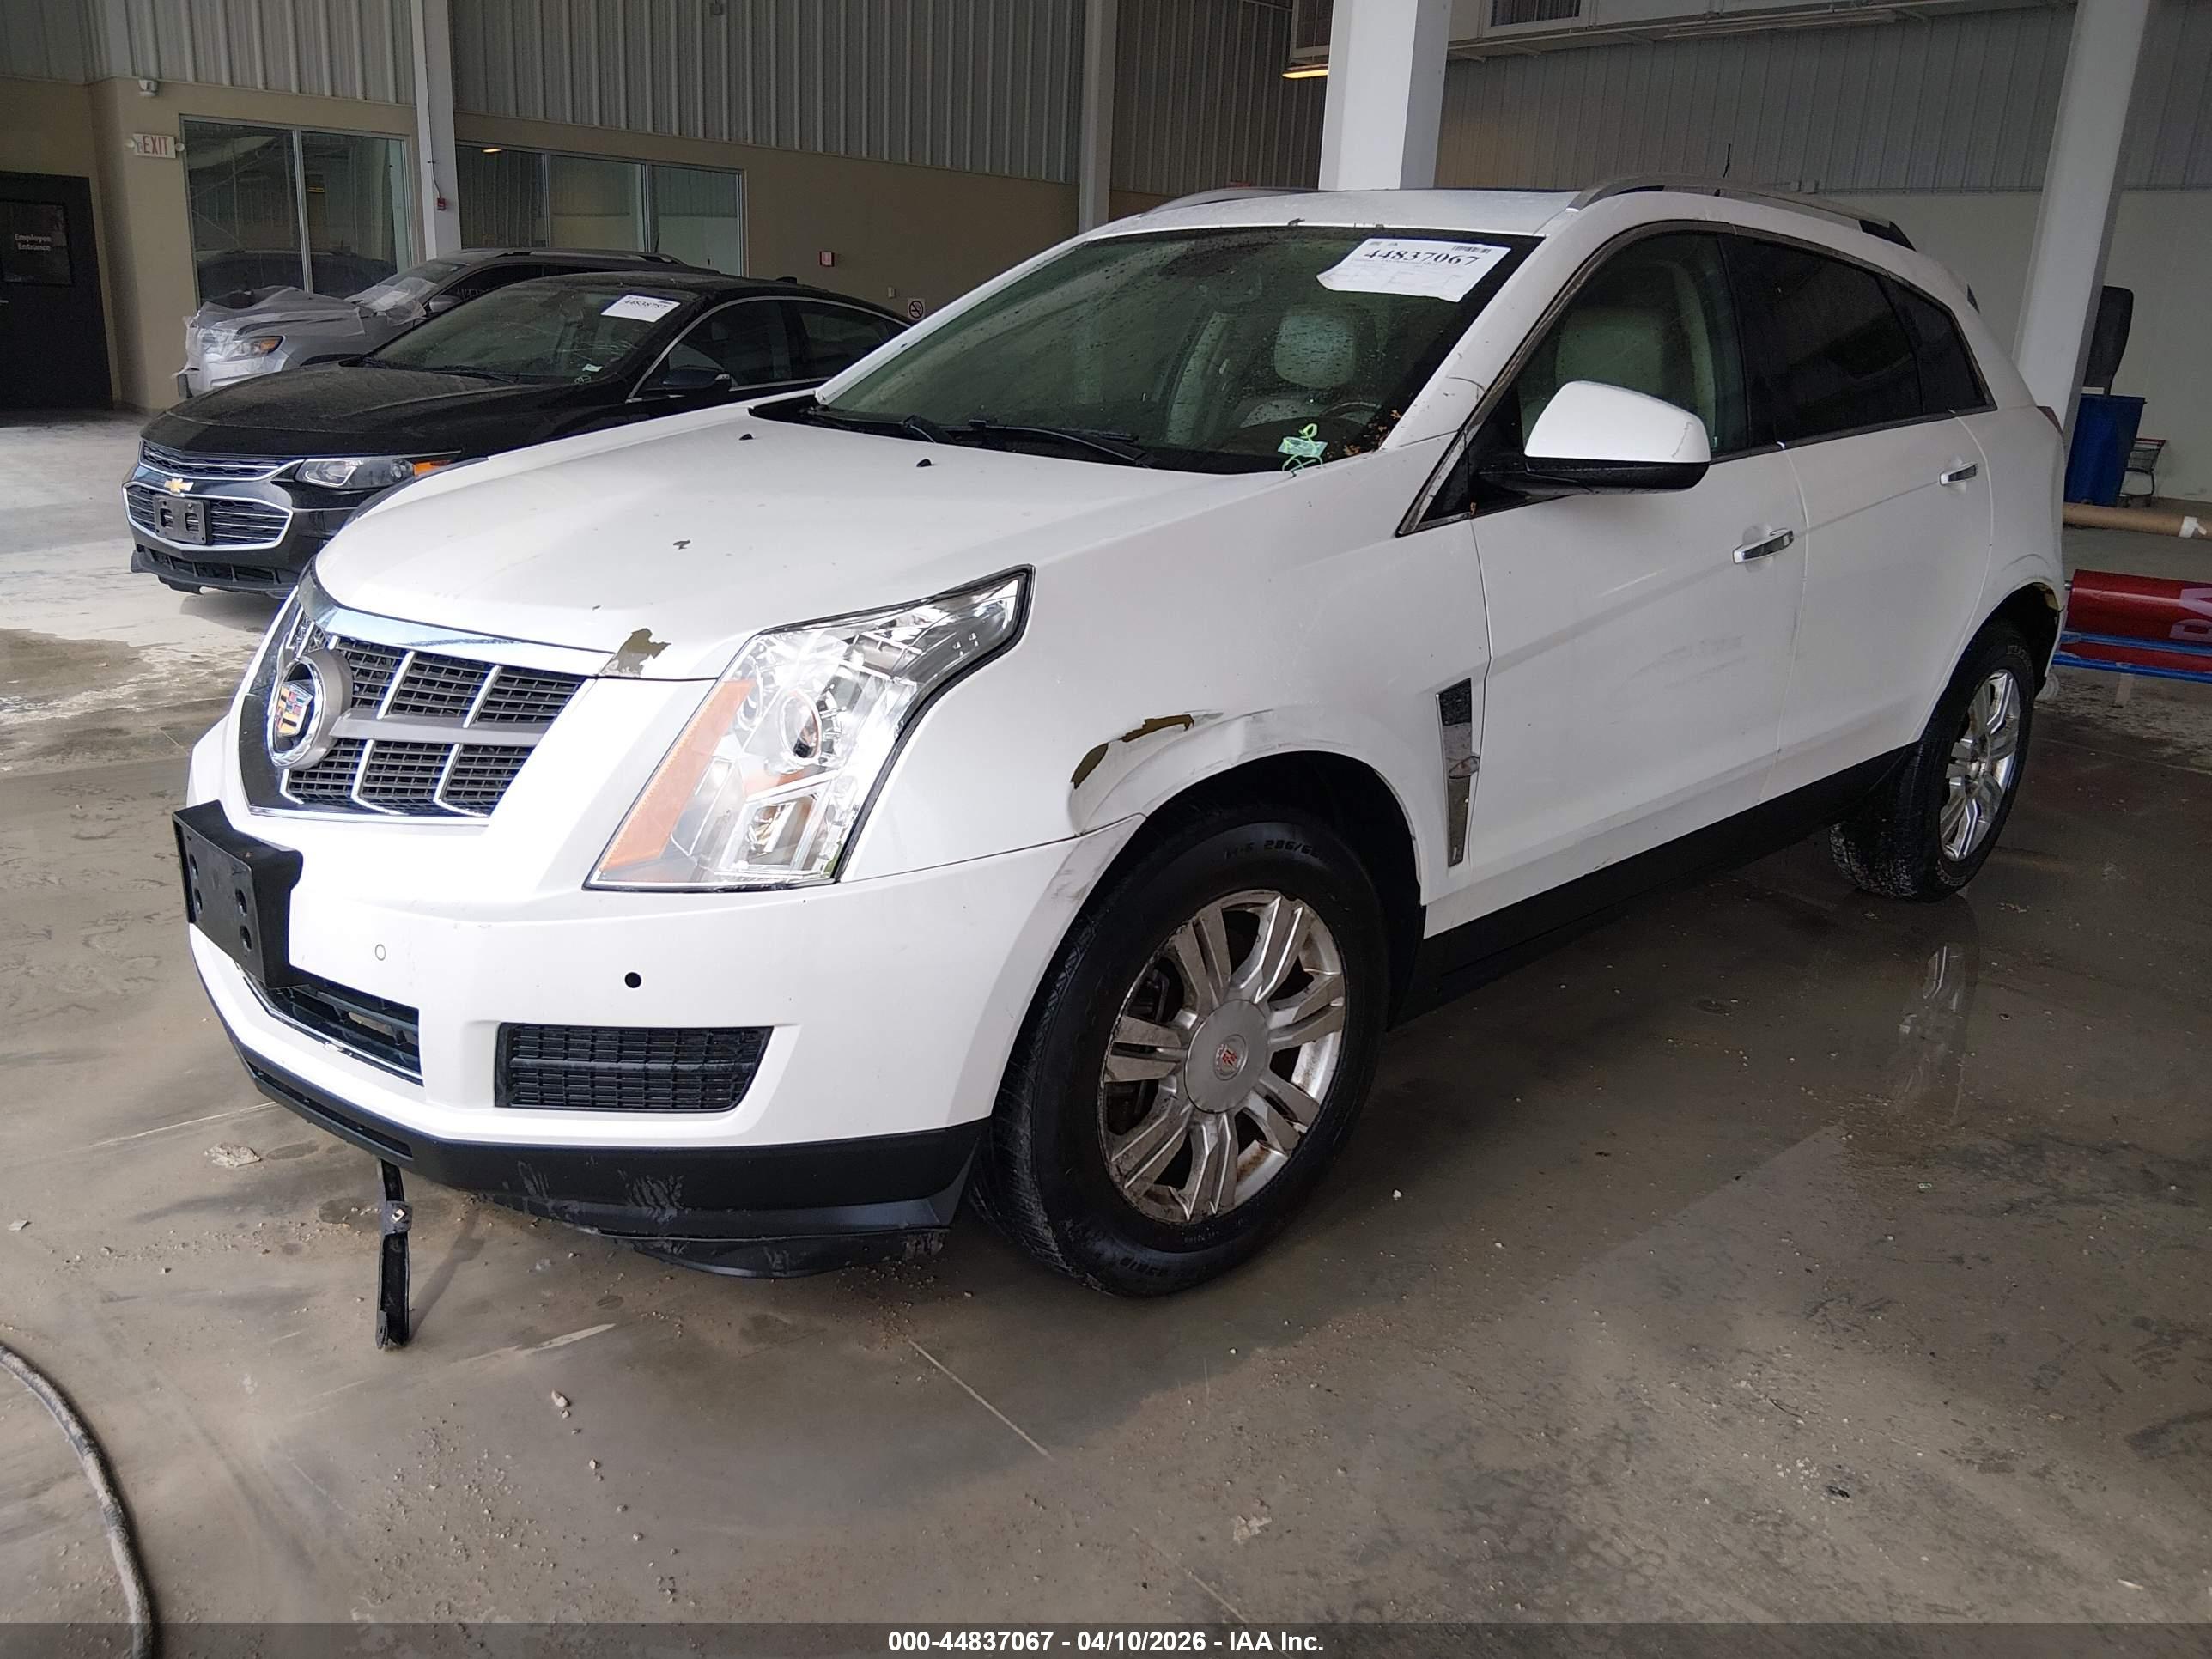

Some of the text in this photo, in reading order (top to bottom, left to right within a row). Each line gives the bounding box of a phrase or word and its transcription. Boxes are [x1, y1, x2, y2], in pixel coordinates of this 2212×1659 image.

[143, 135, 169, 155] EXIT
[14, 234, 52, 243] Employee
[17, 242, 52, 252] Entrance
[1364, 249, 1481, 266] 44837067
